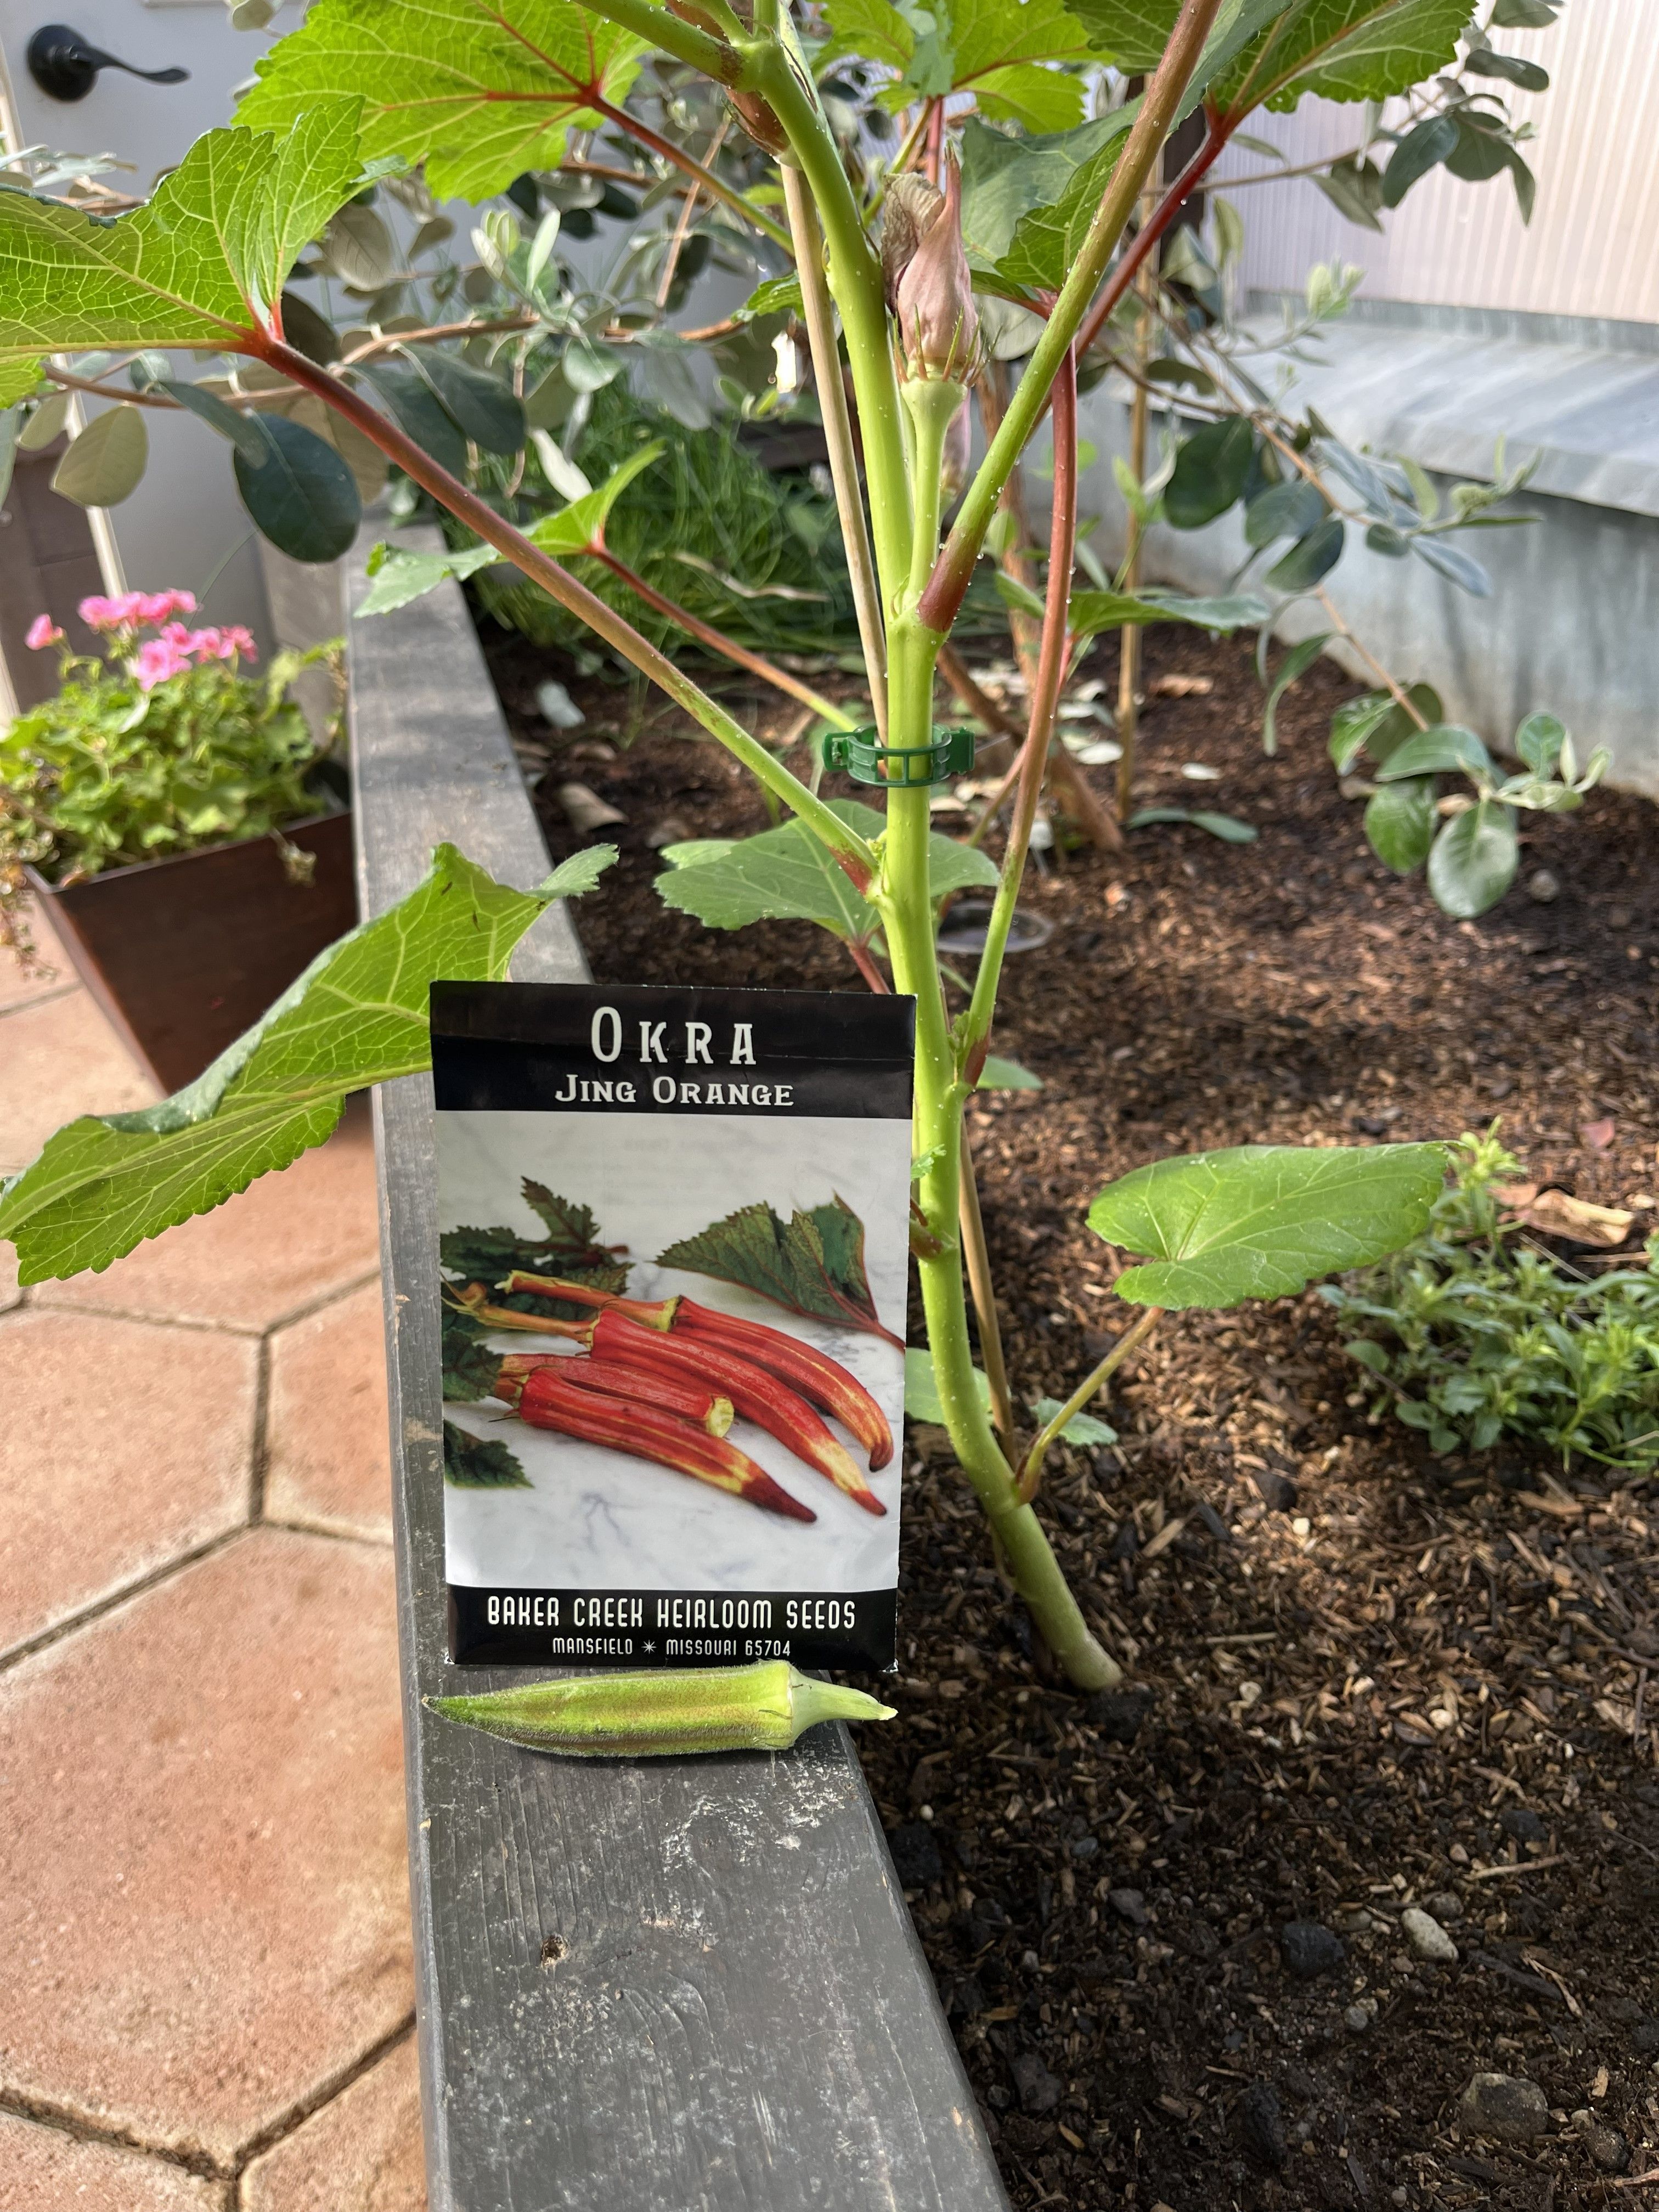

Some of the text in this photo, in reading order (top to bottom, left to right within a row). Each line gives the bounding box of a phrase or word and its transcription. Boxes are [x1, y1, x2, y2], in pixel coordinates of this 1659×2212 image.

[591, 1006, 758, 1065] OKRA
[555, 1074, 794, 1107] JING ORANGE
[487, 1595, 856, 1629] BAKER CREEK HEIRLOOM SEEDS
[552, 1637, 791, 1657] MANSFIELD MISSOURI 65704
